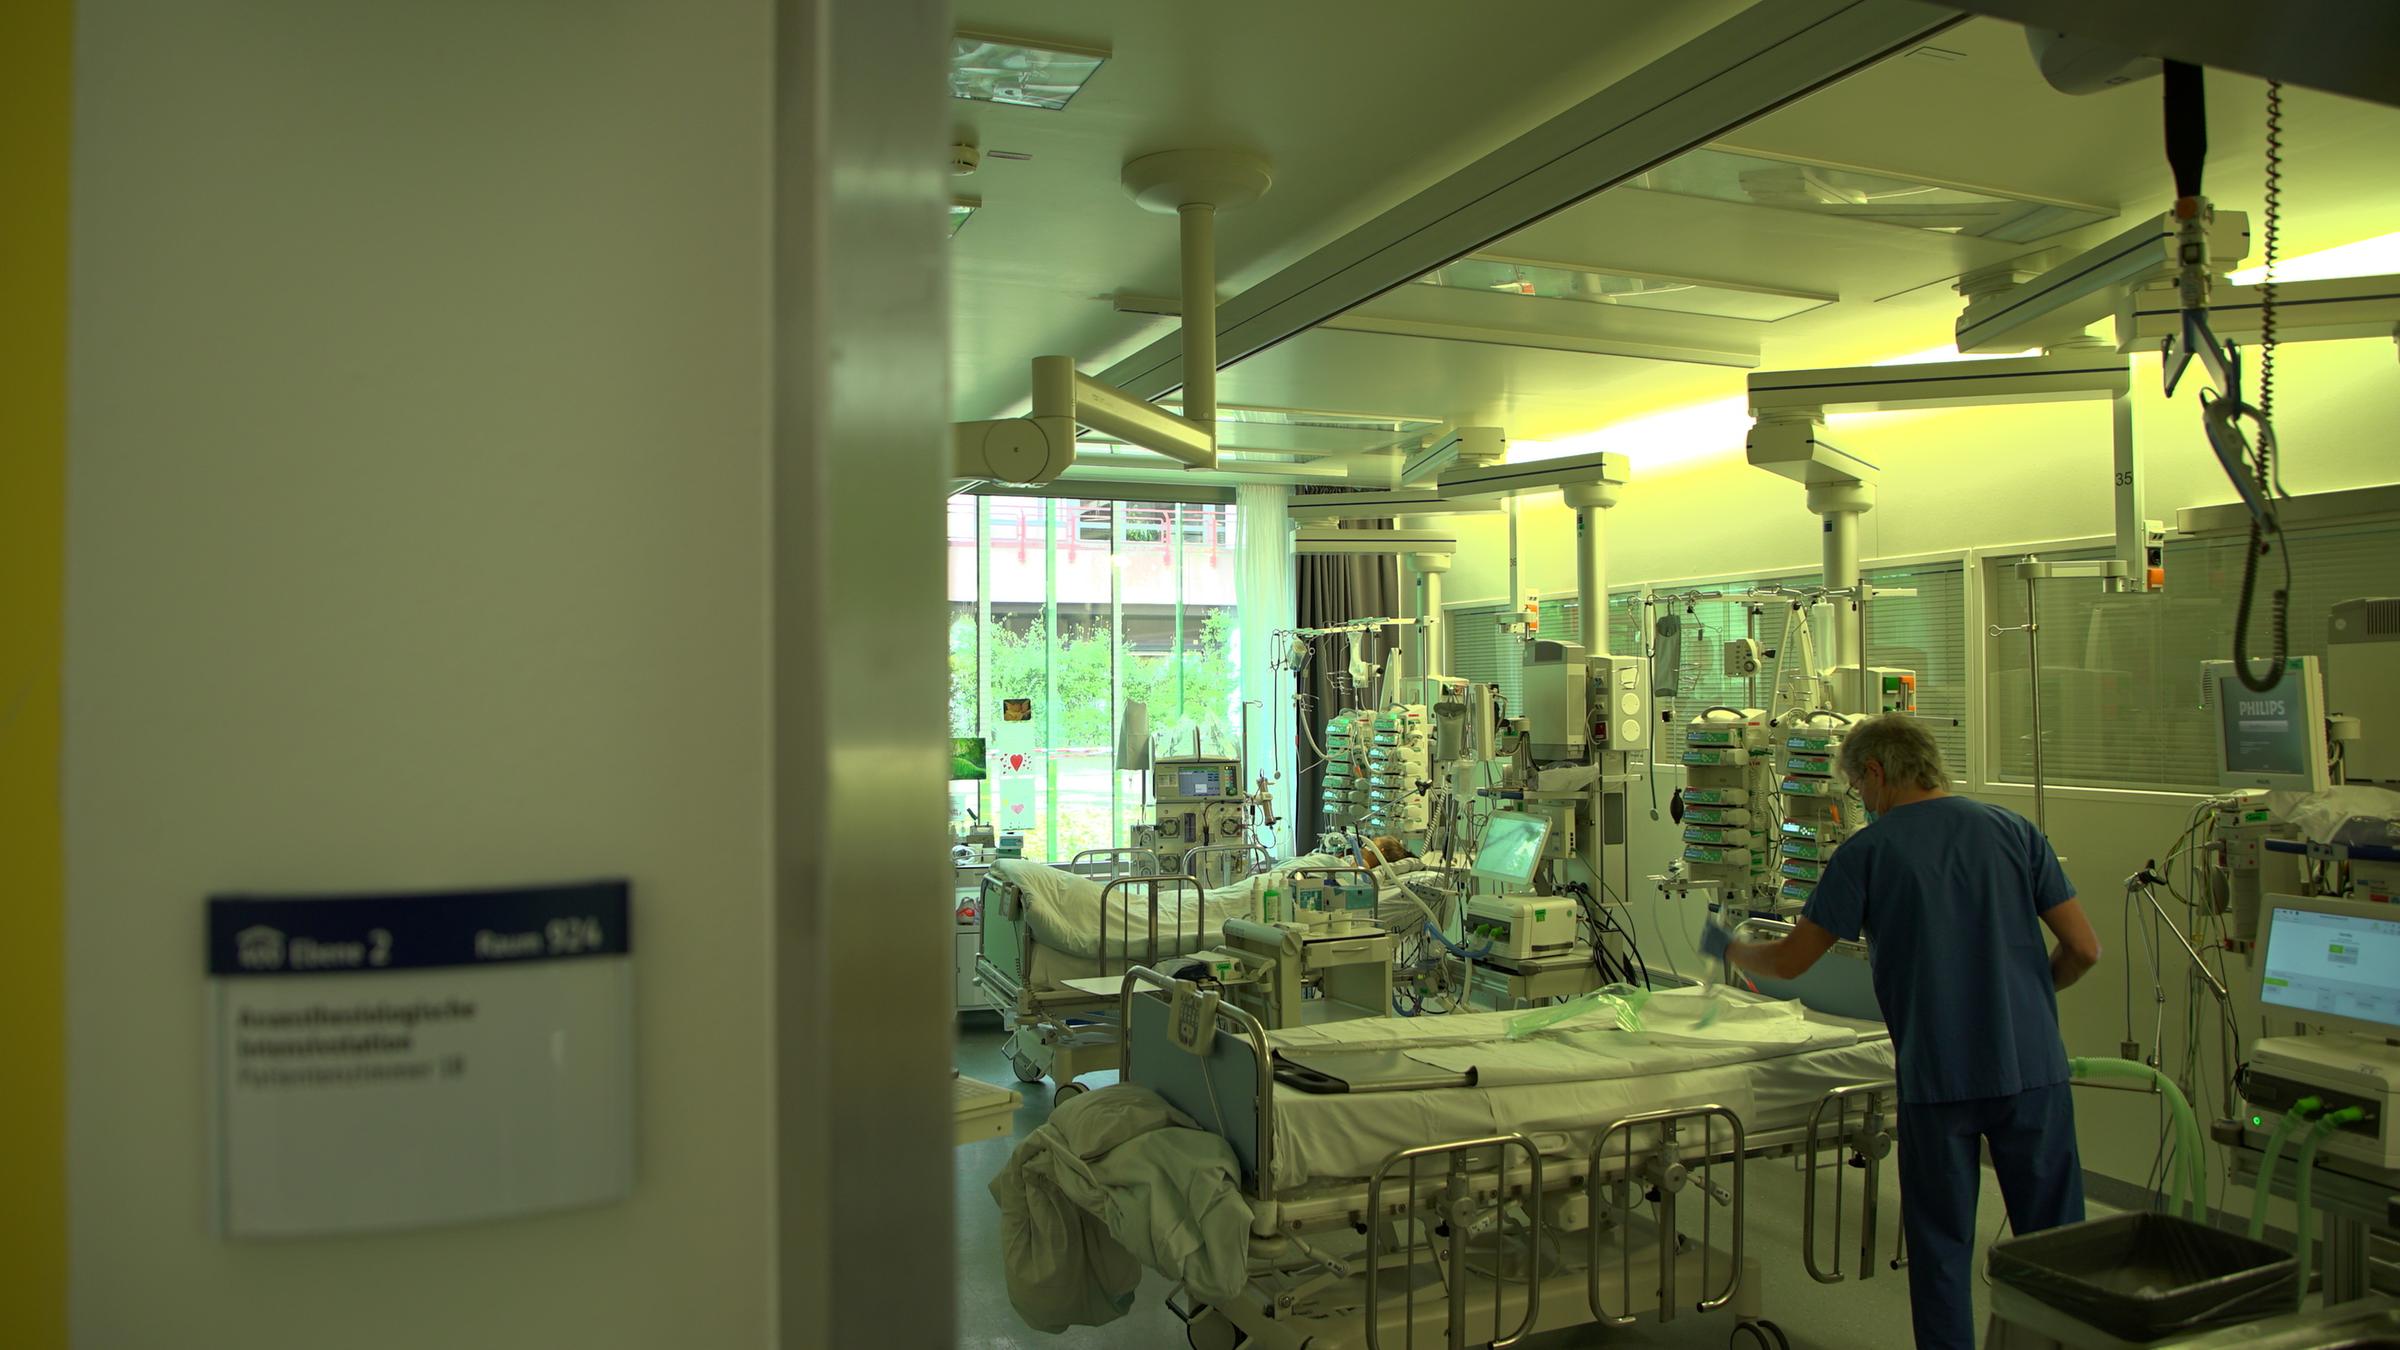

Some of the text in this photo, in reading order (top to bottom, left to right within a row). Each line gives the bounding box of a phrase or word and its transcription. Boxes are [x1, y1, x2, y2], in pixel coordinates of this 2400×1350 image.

[2115, 471, 2133, 486] 35
[2239, 700, 2286, 716] PHILIPS
[289, 938, 365, 968] Ebene
[368, 928, 393, 967] 2
[475, 929, 542, 959] Raum
